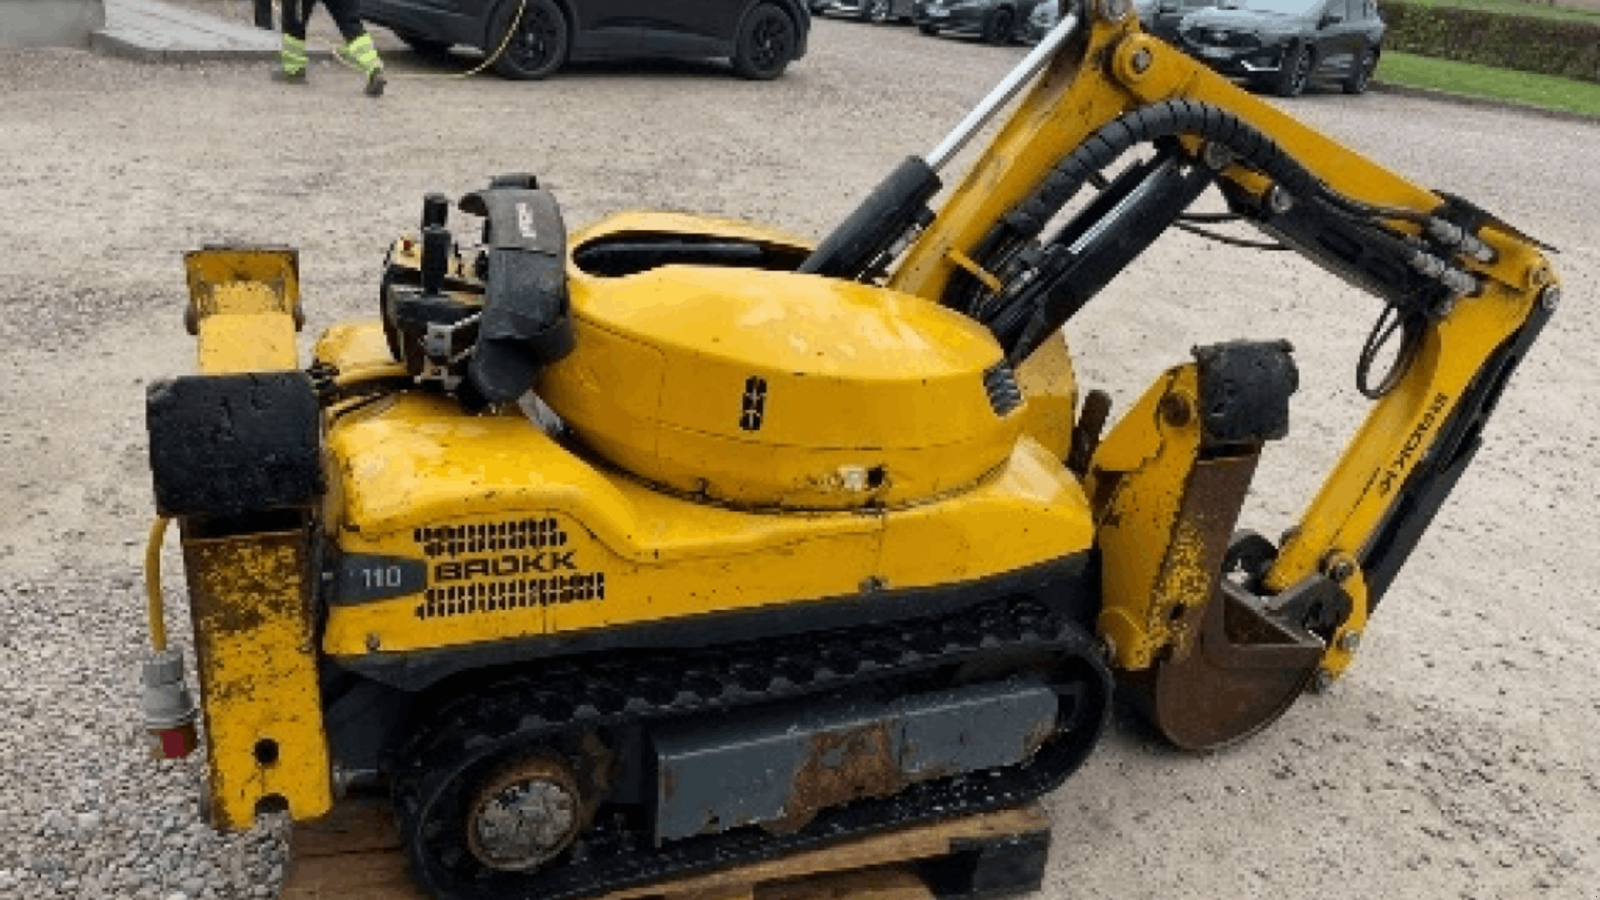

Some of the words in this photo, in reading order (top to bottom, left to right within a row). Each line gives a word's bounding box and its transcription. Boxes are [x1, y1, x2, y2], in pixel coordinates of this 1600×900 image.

[1379, 393, 1448, 497] BROKK
[362, 566, 401, 588] 110
[435, 551, 577, 581] BROKK
